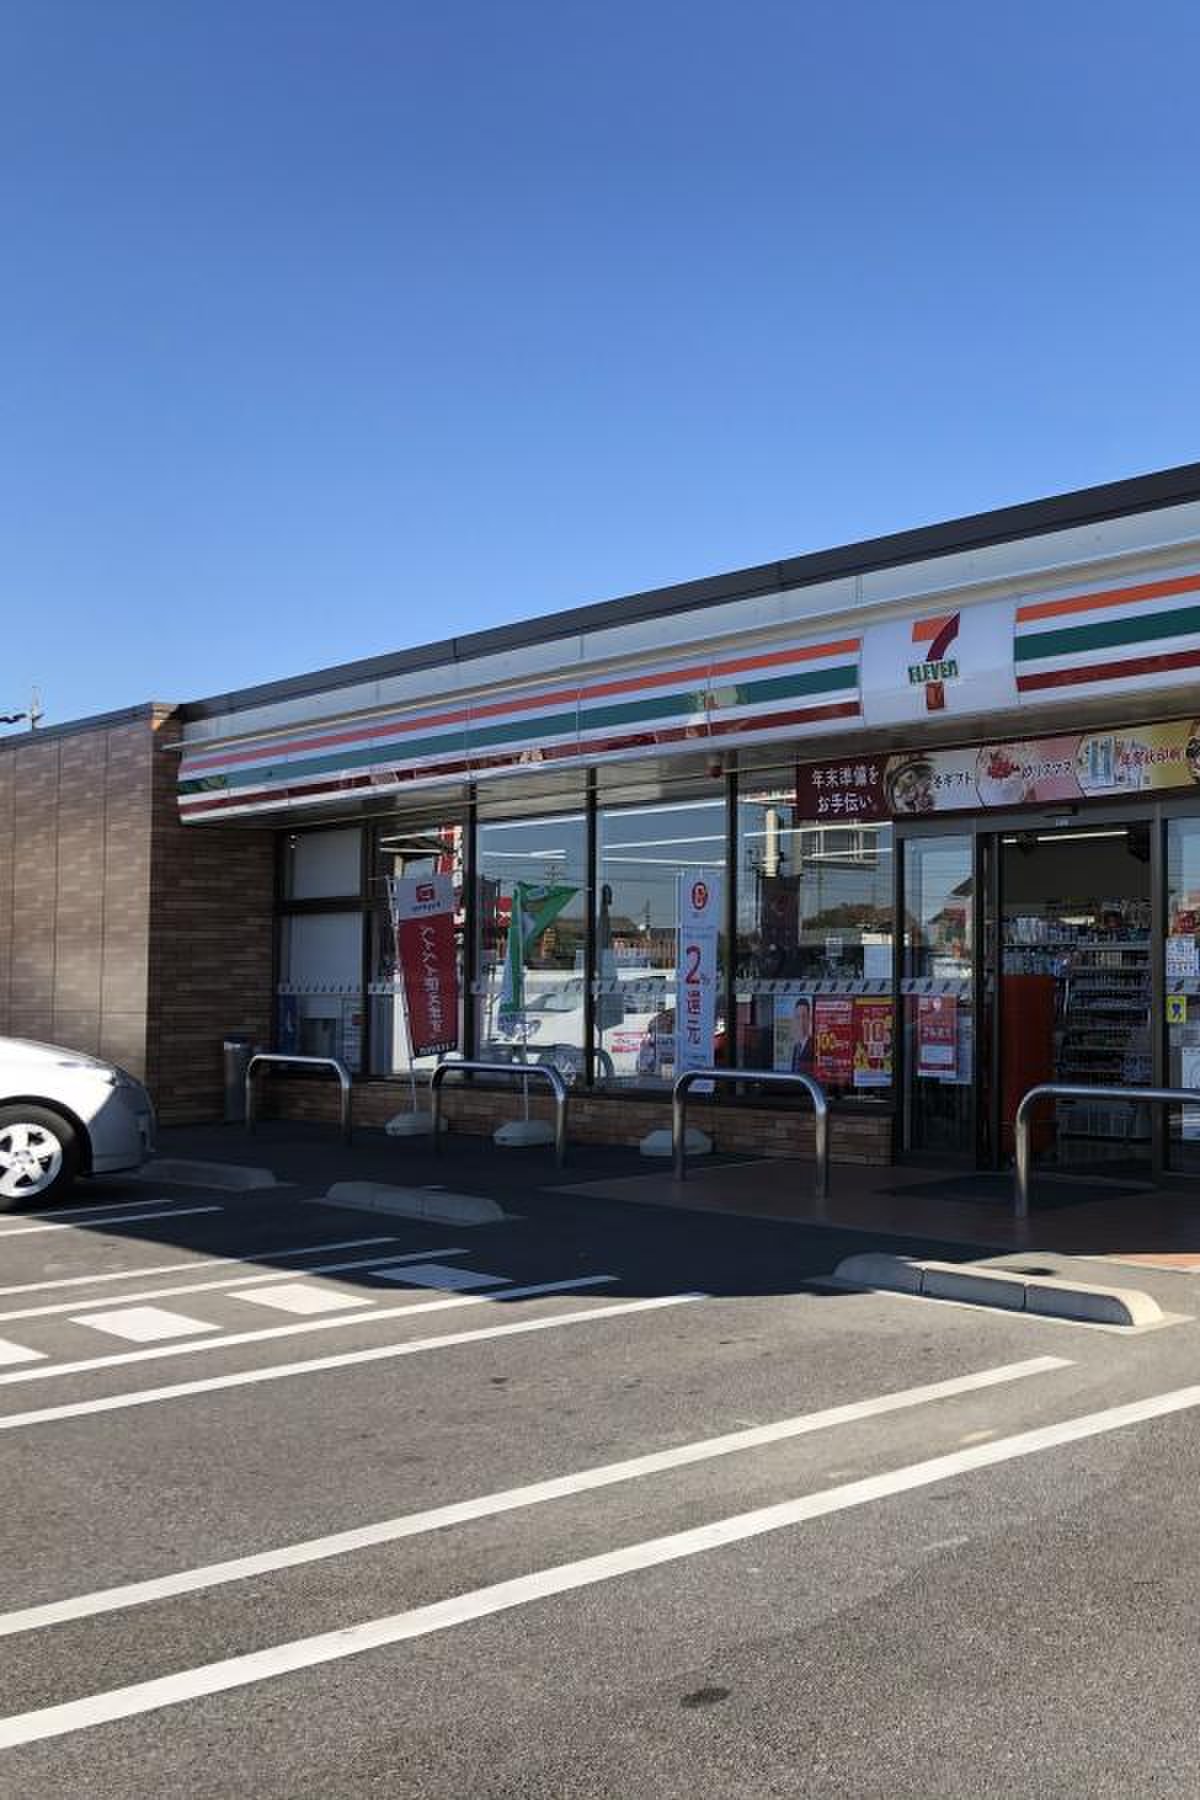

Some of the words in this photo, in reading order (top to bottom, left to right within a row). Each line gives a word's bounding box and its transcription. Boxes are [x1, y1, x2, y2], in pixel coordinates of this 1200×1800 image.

[811, 765, 880, 788] 年末準備を
